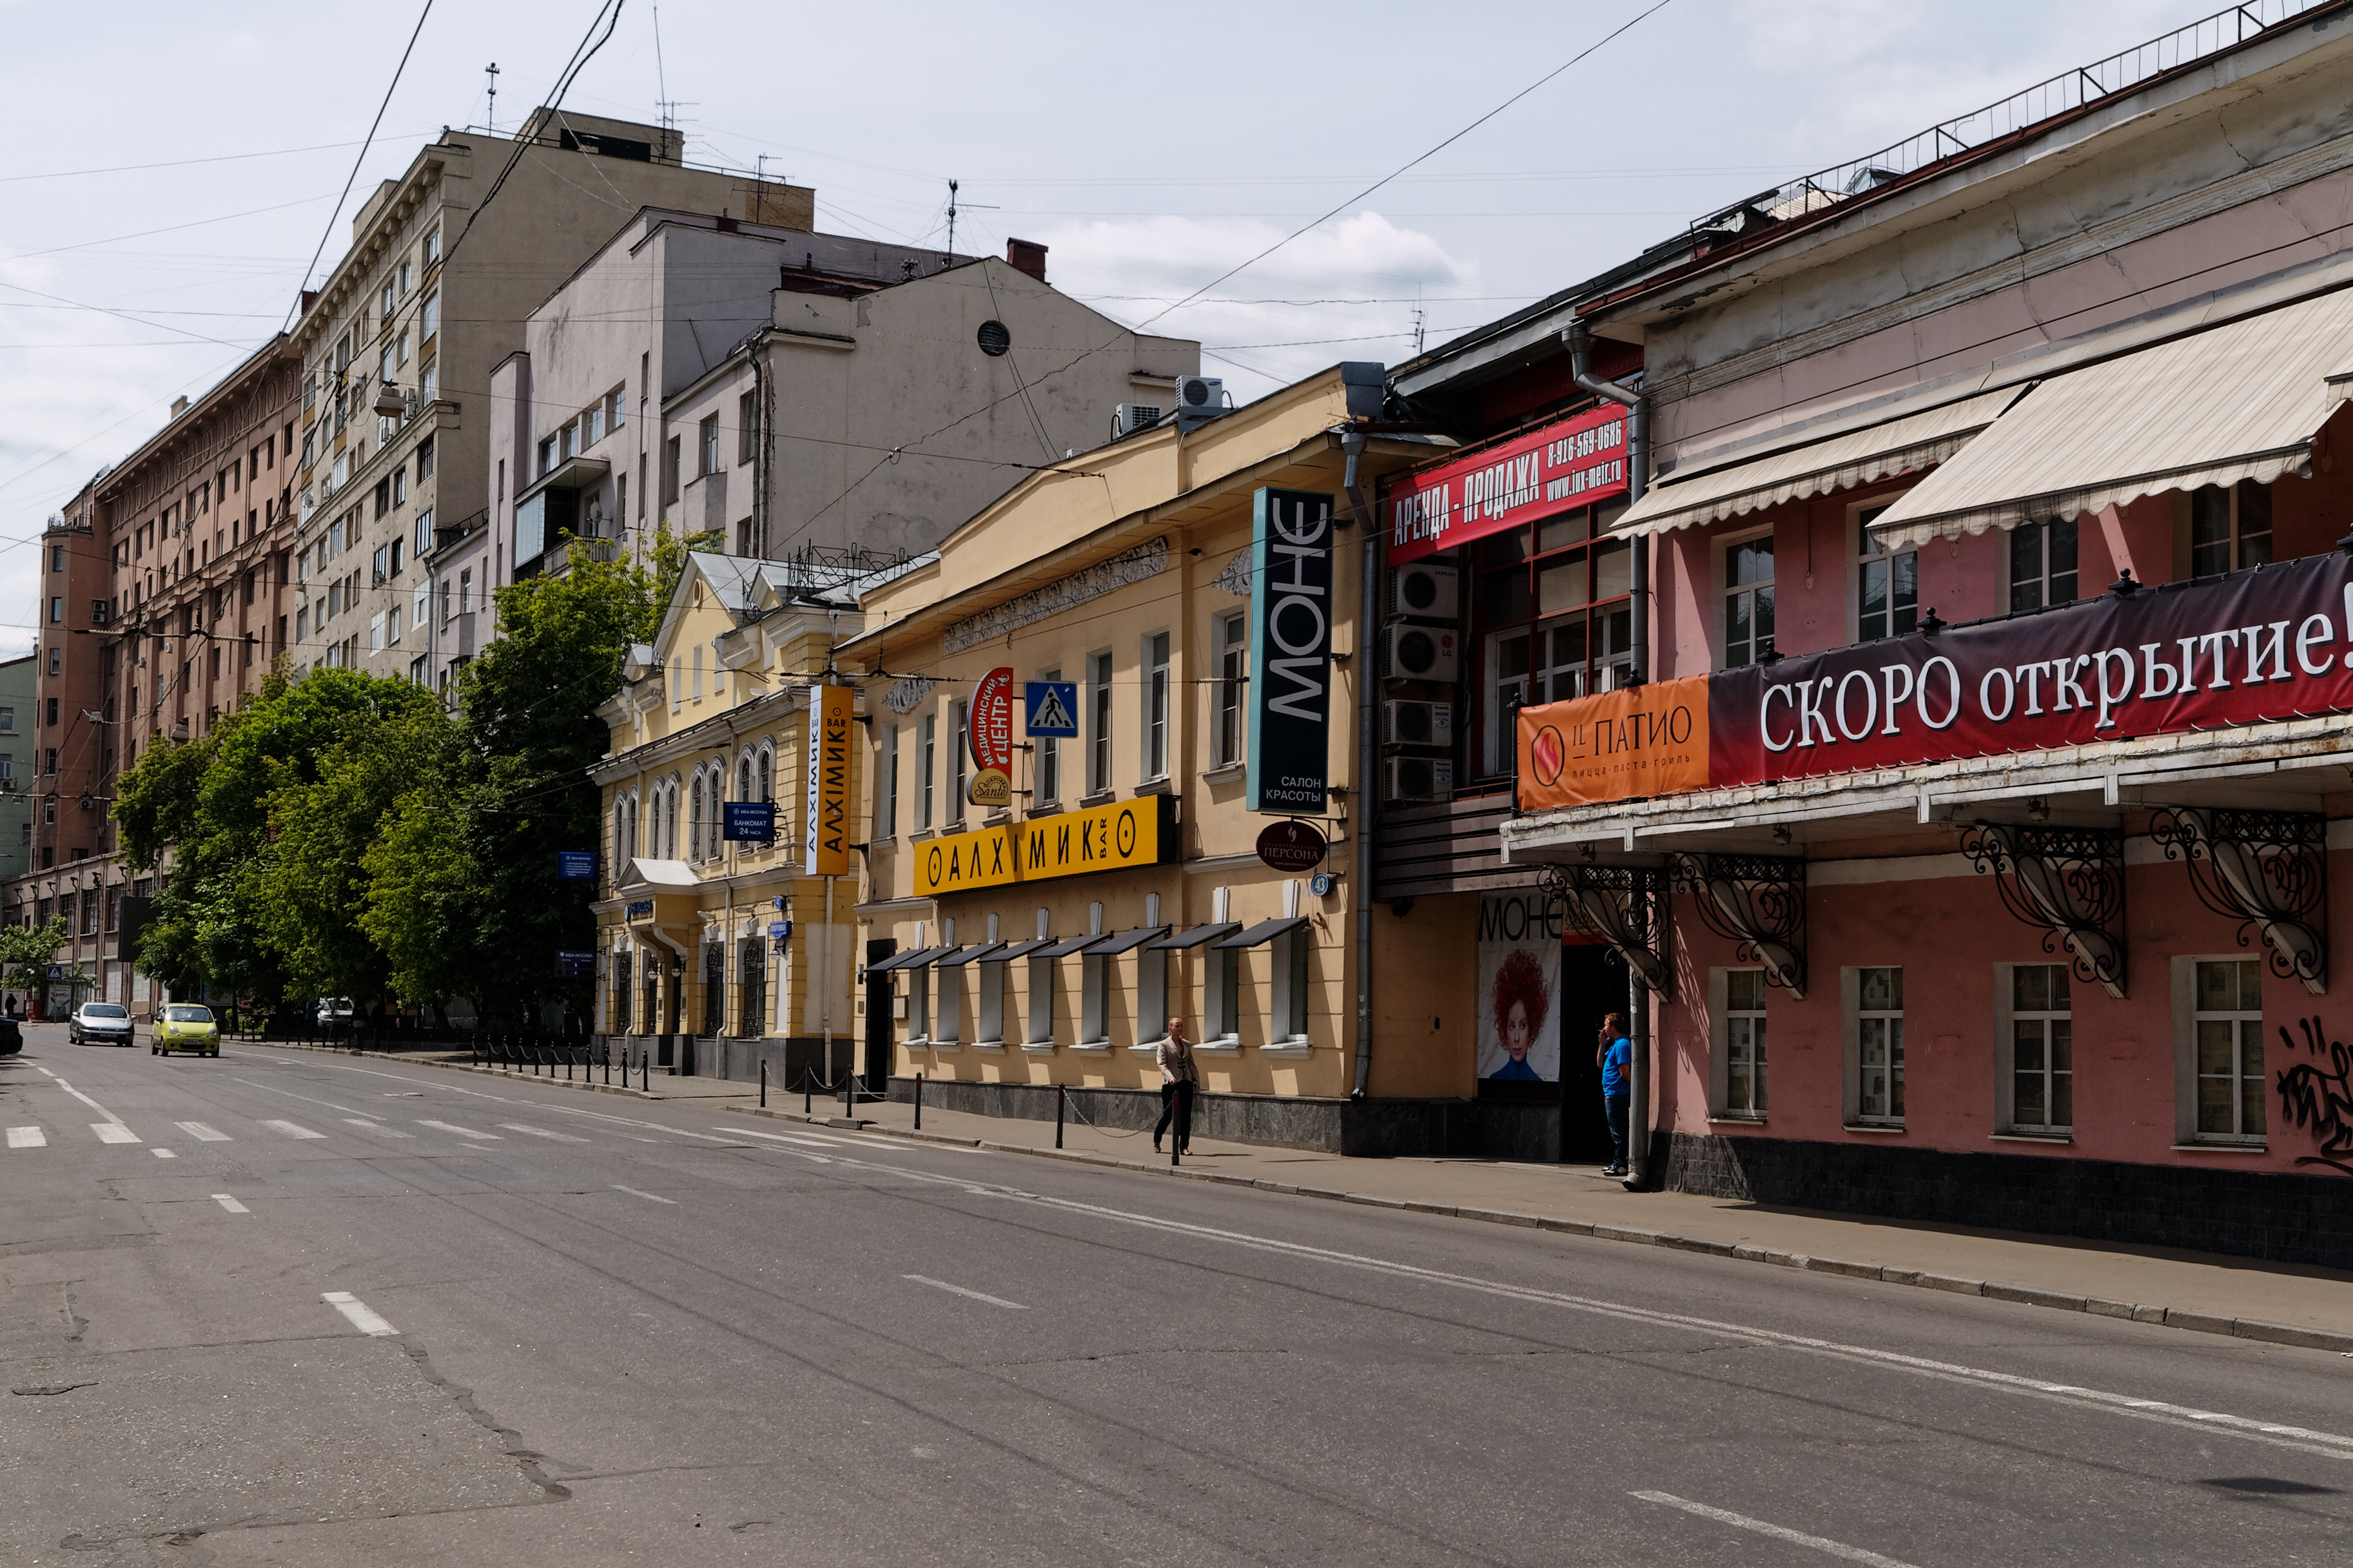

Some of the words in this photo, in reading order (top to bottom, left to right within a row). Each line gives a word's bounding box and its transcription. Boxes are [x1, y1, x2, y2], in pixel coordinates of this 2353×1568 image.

[1547, 418, 1622, 469] 8-916-569-0686
[1394, 482, 1450, 547] АРЕНДА
[1463, 450, 1539, 524] ПРОДАЖА
[1267, 498, 1327, 722] МОНЕ
[827, 718, 846, 727] BAR
[977, 678, 998, 767] МЕДИЦИНСКИЙ
[990, 695, 1010, 751] ЦЕНТР
[1760, 655, 1962, 752] СКОРО
[1594, 705, 1692, 756] ПАТИО
[1266, 789, 1321, 802] КРАСОТЫ
[1281, 776, 1321, 789] САЛОН
[1099, 817, 1108, 858] BAR
[1264, 847, 1319, 860] ПЕРСОНА
[1314, 877, 1325, 891] 43
